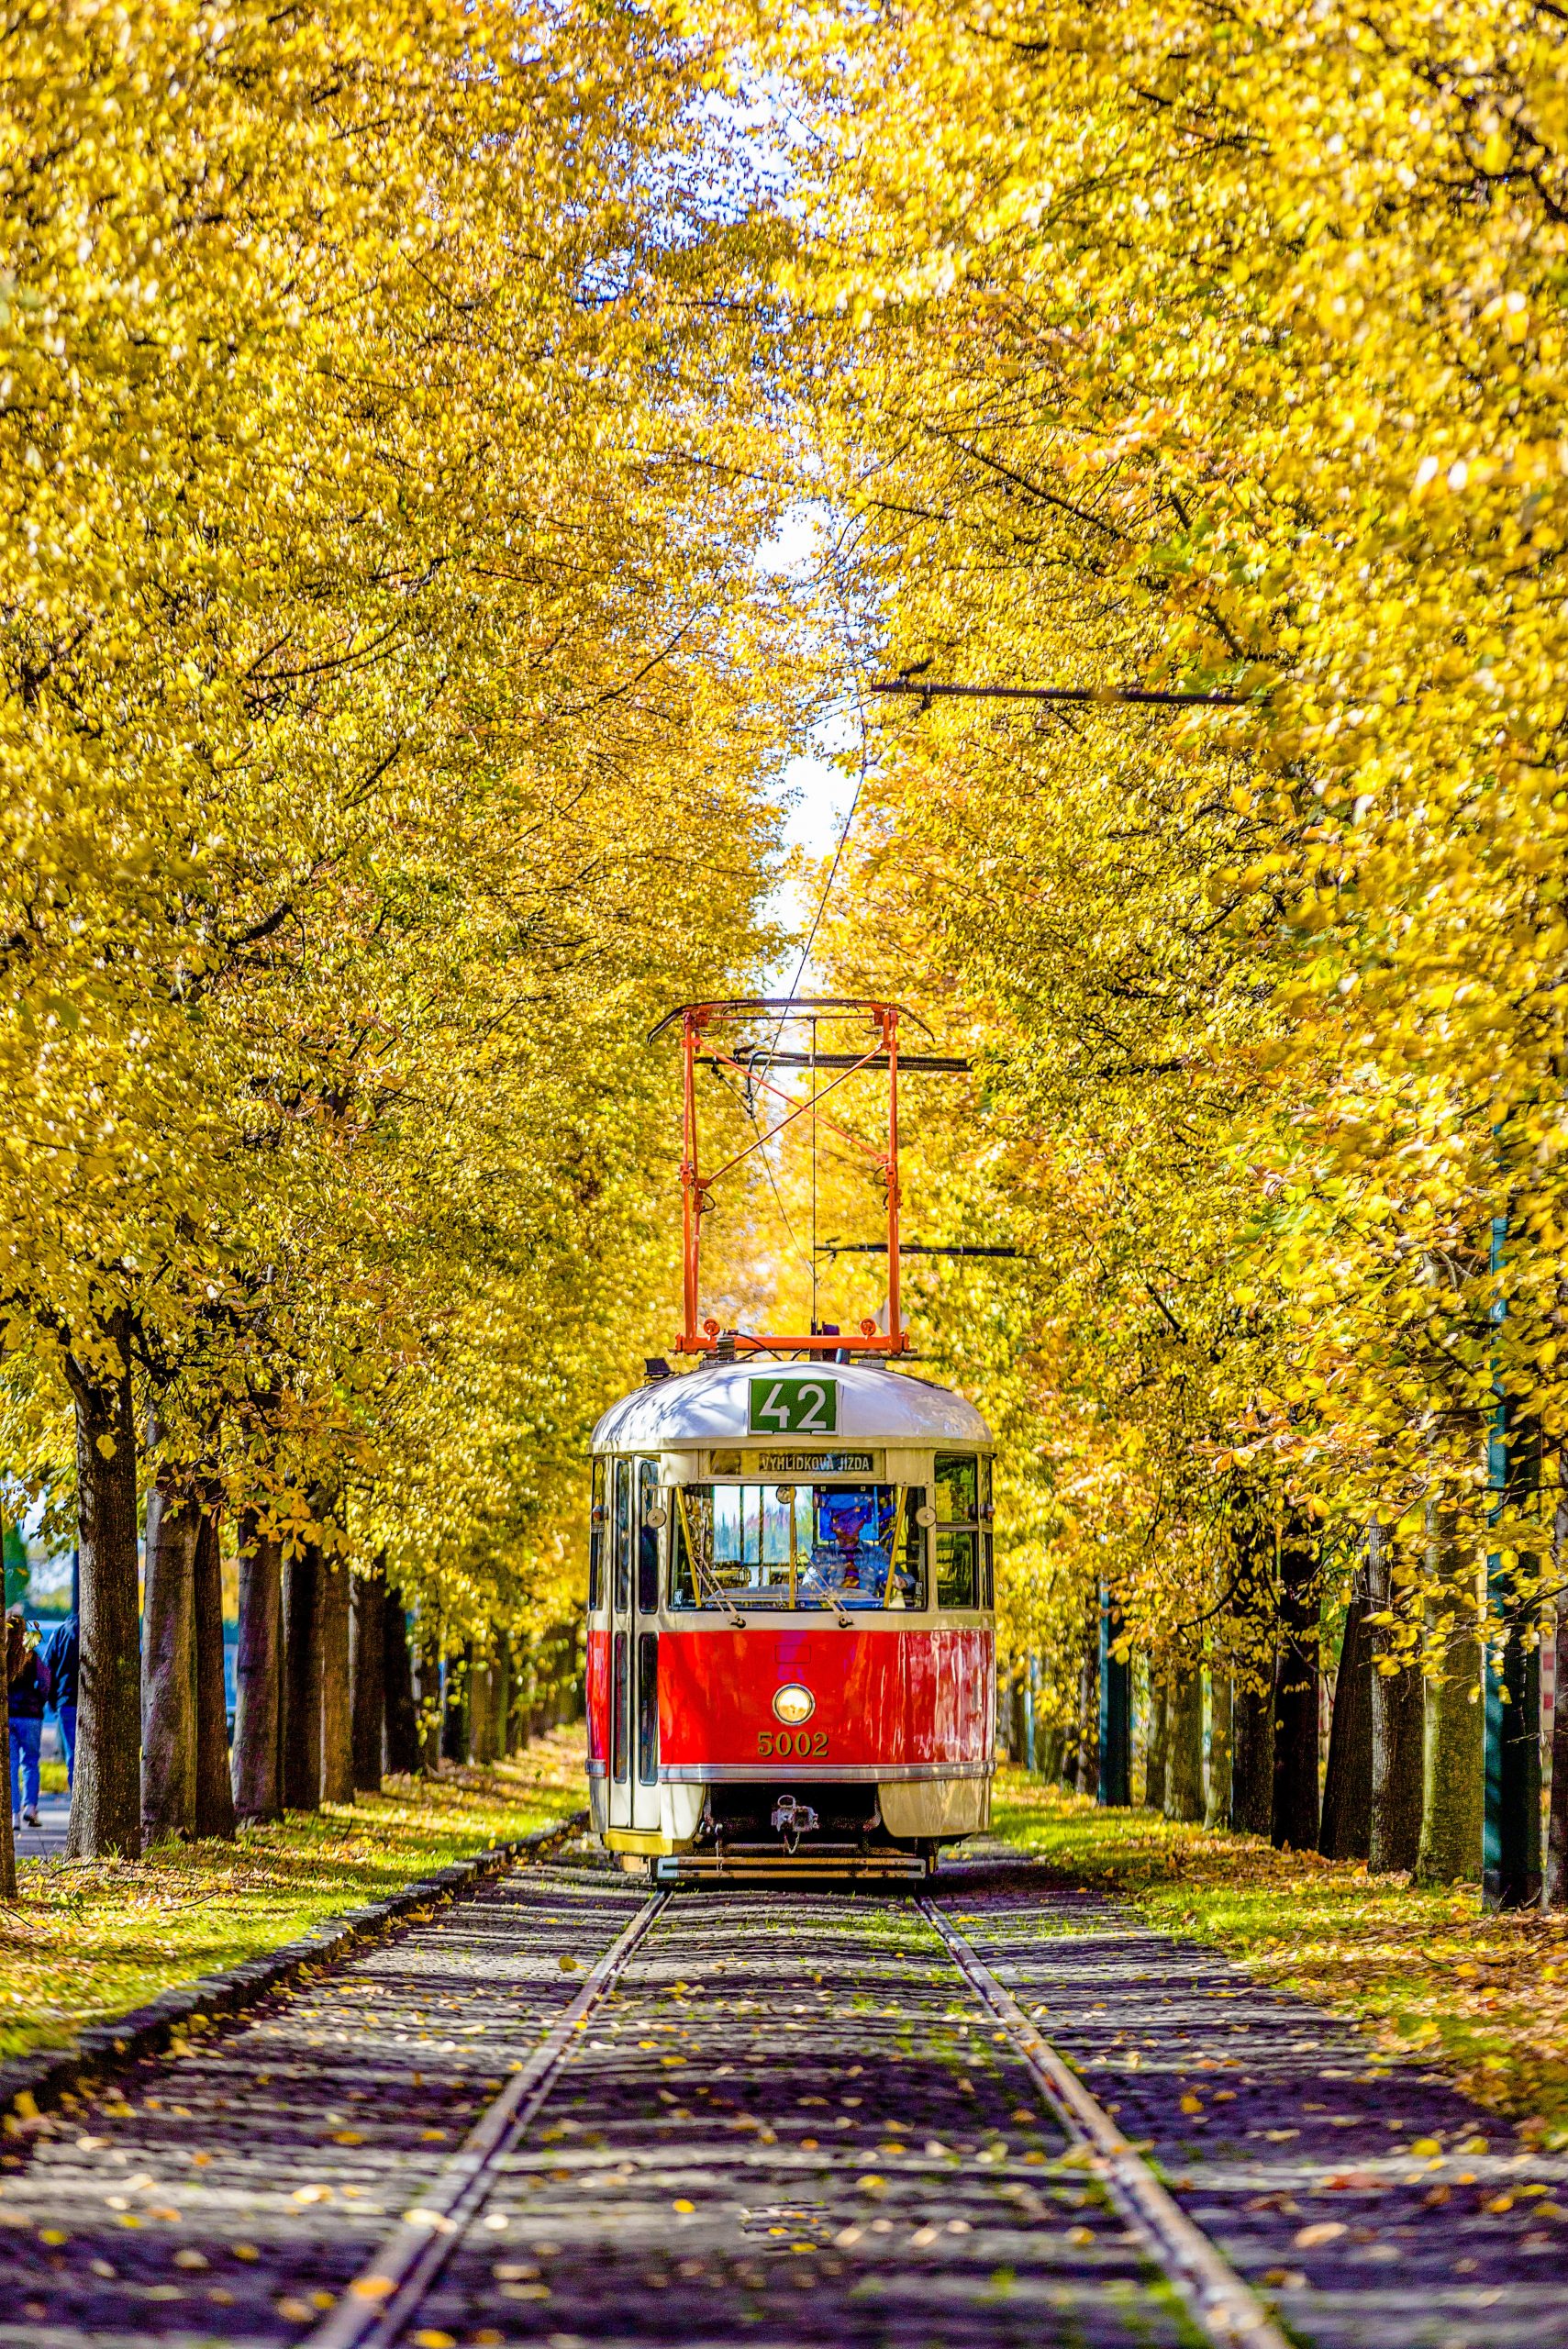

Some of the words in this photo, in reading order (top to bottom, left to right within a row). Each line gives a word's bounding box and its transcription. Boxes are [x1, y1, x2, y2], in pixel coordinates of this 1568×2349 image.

[759, 1383, 827, 1429] 42
[761, 1454, 834, 1471] VYHLÍDKOVÁ
[839, 1454, 870, 1471] JÍZDA
[758, 1731, 829, 1757] 5002
